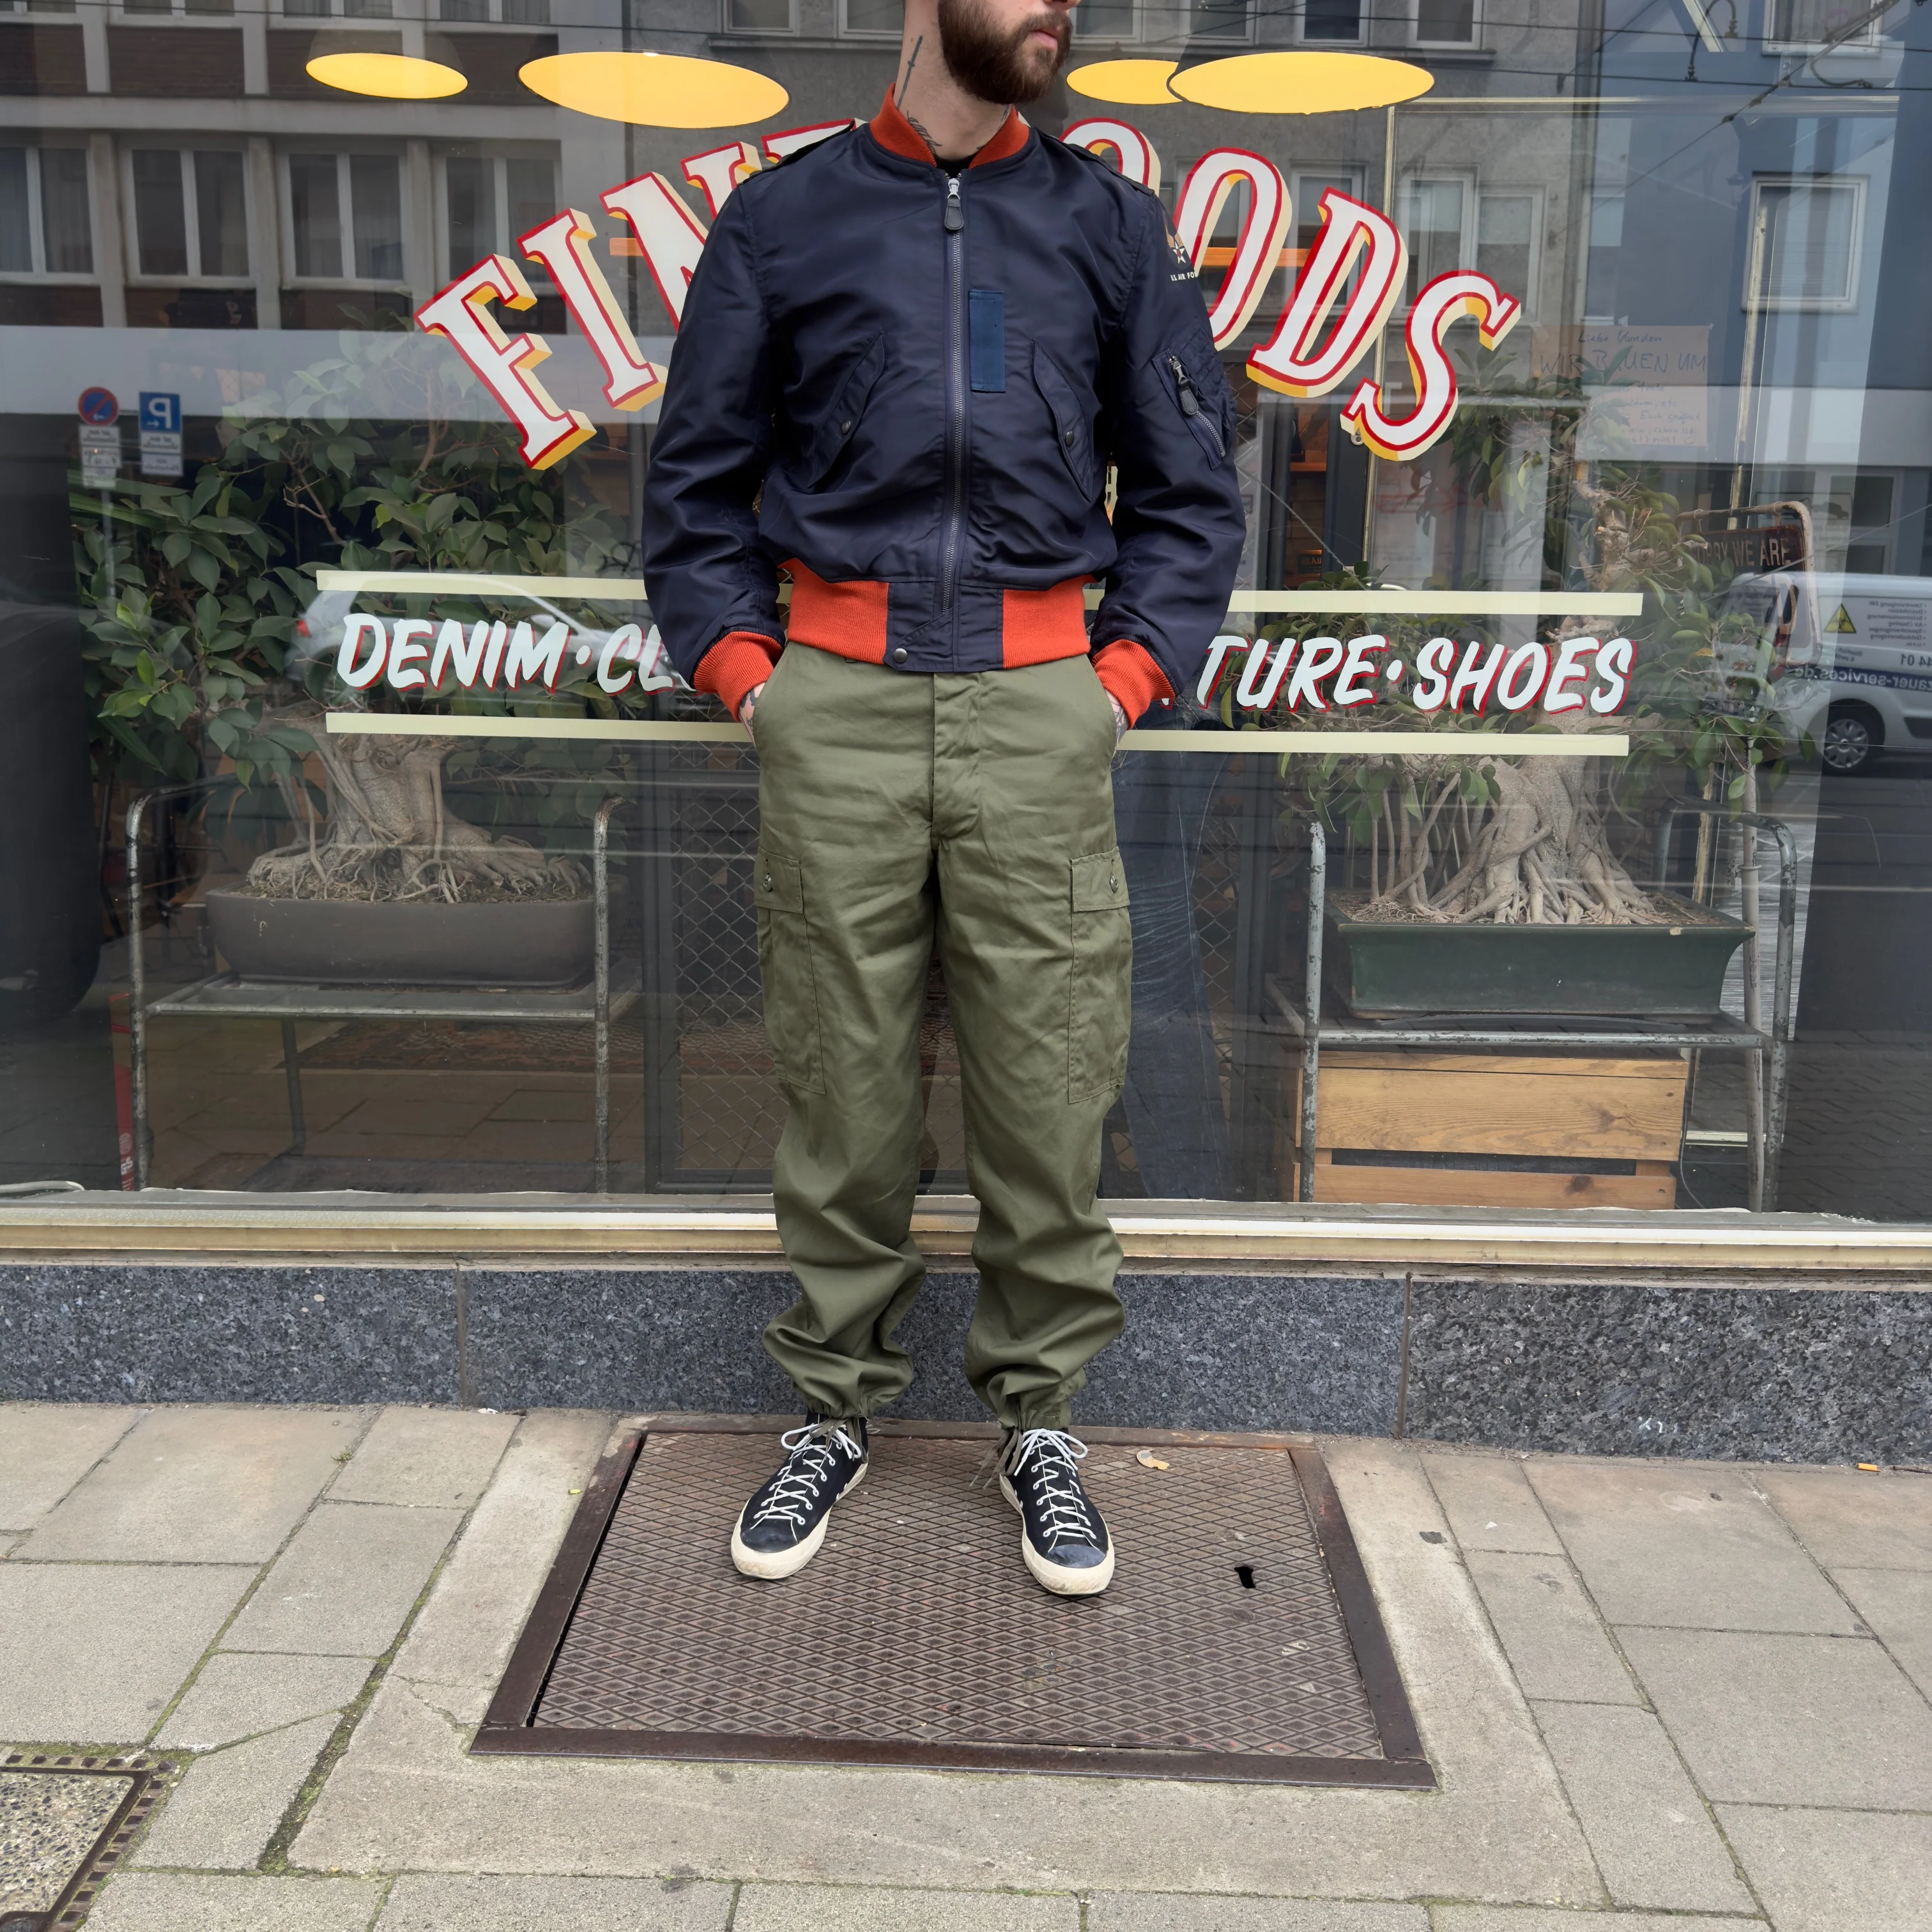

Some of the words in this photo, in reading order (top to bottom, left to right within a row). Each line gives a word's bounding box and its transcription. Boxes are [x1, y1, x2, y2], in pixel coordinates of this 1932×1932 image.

[413, 118, 869, 470] FIN
[1057, 117, 1521, 461] ODS
[1540, 352, 1582, 374] WIR
[1591, 349, 1668, 373] BUEN
[1678, 353, 1706, 372] UM
[1697, 540, 1728, 565] ORRY
[1733, 539, 1755, 566] WE
[1760, 537, 1791, 566] ARE
[337, 613, 572, 694] DENIM
[597, 624, 696, 696] CL
[1160, 634, 1390, 713] TURE
[1412, 637, 1638, 718] SHOES
